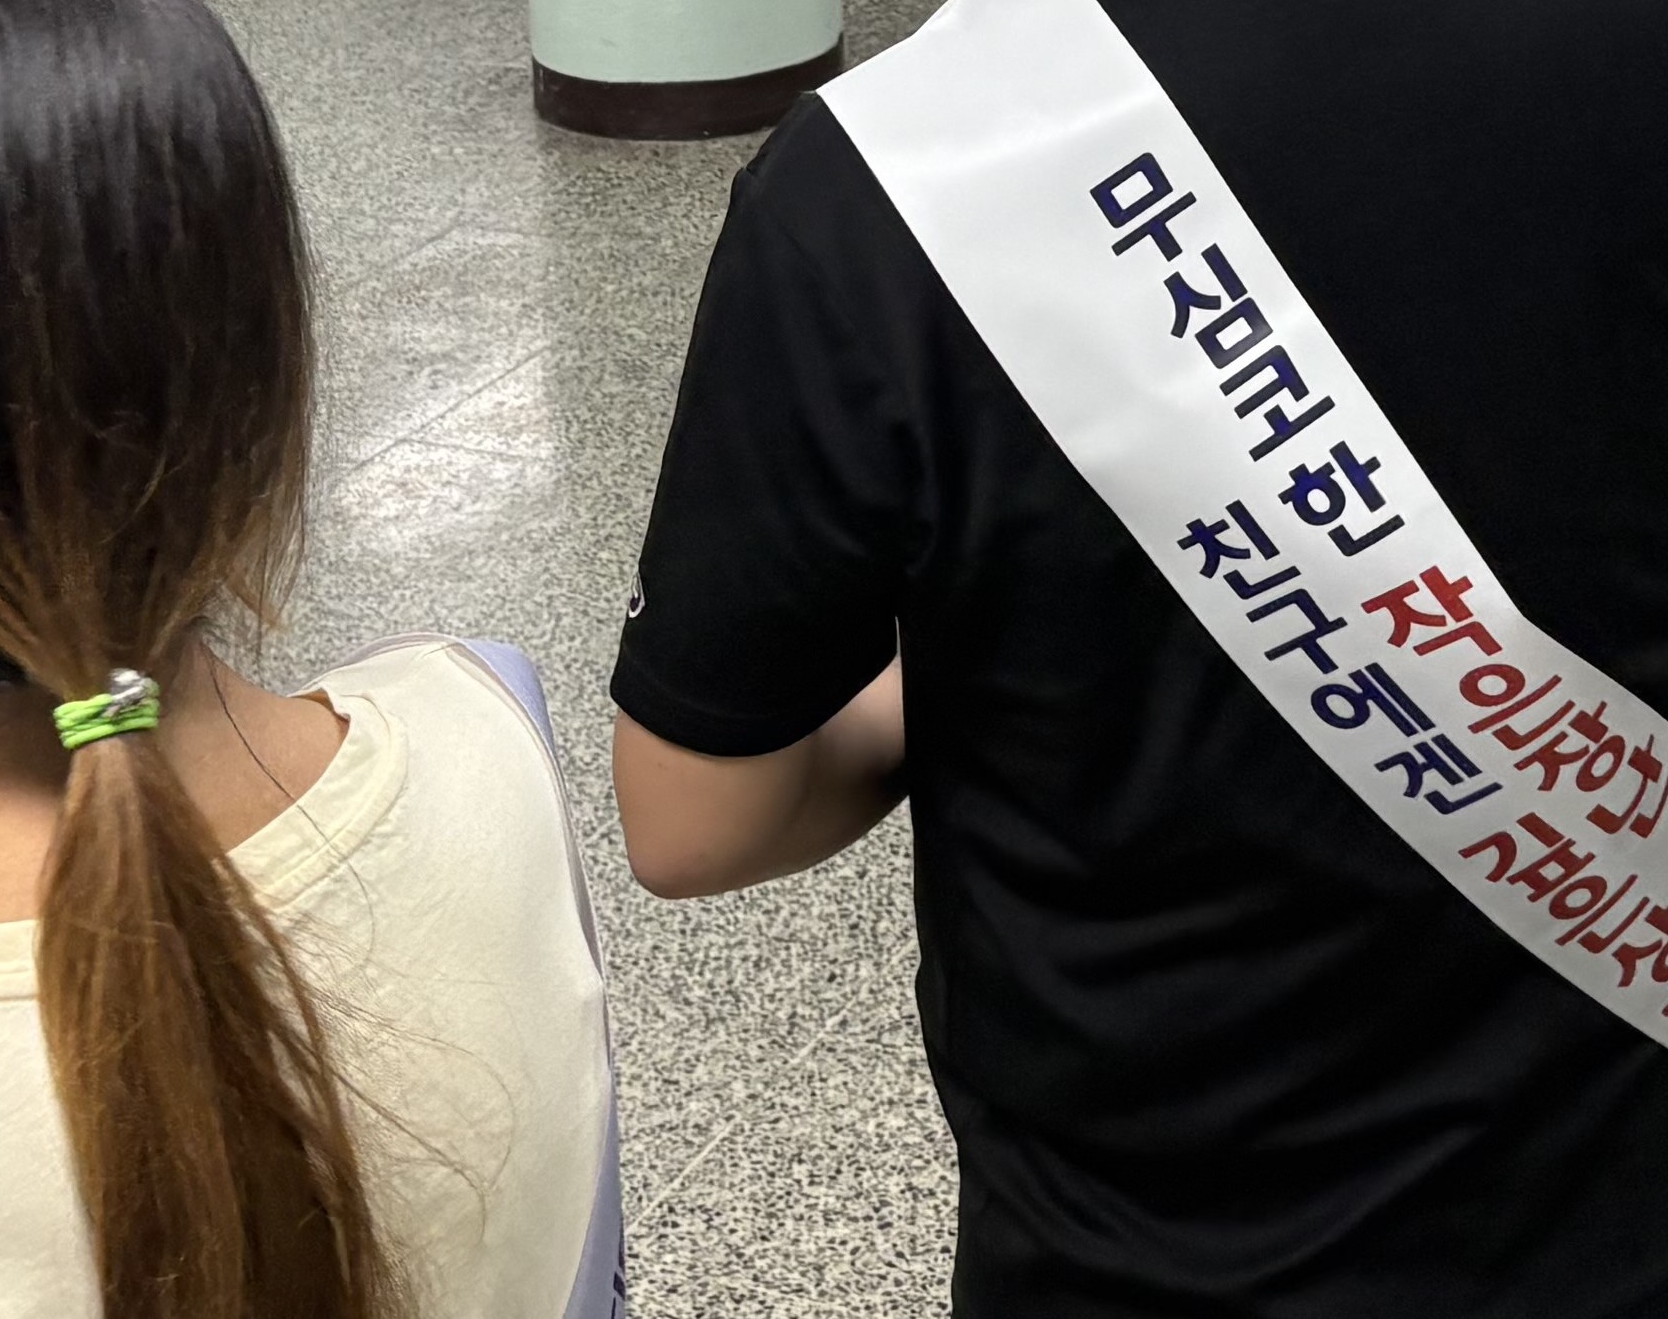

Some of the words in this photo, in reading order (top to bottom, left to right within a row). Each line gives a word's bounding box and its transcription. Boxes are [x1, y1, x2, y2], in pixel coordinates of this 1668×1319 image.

[1089, 152, 1336, 463] 무심코
[1277, 440, 1405, 557] 한
[1176, 498, 1504, 816] 친구에겐
